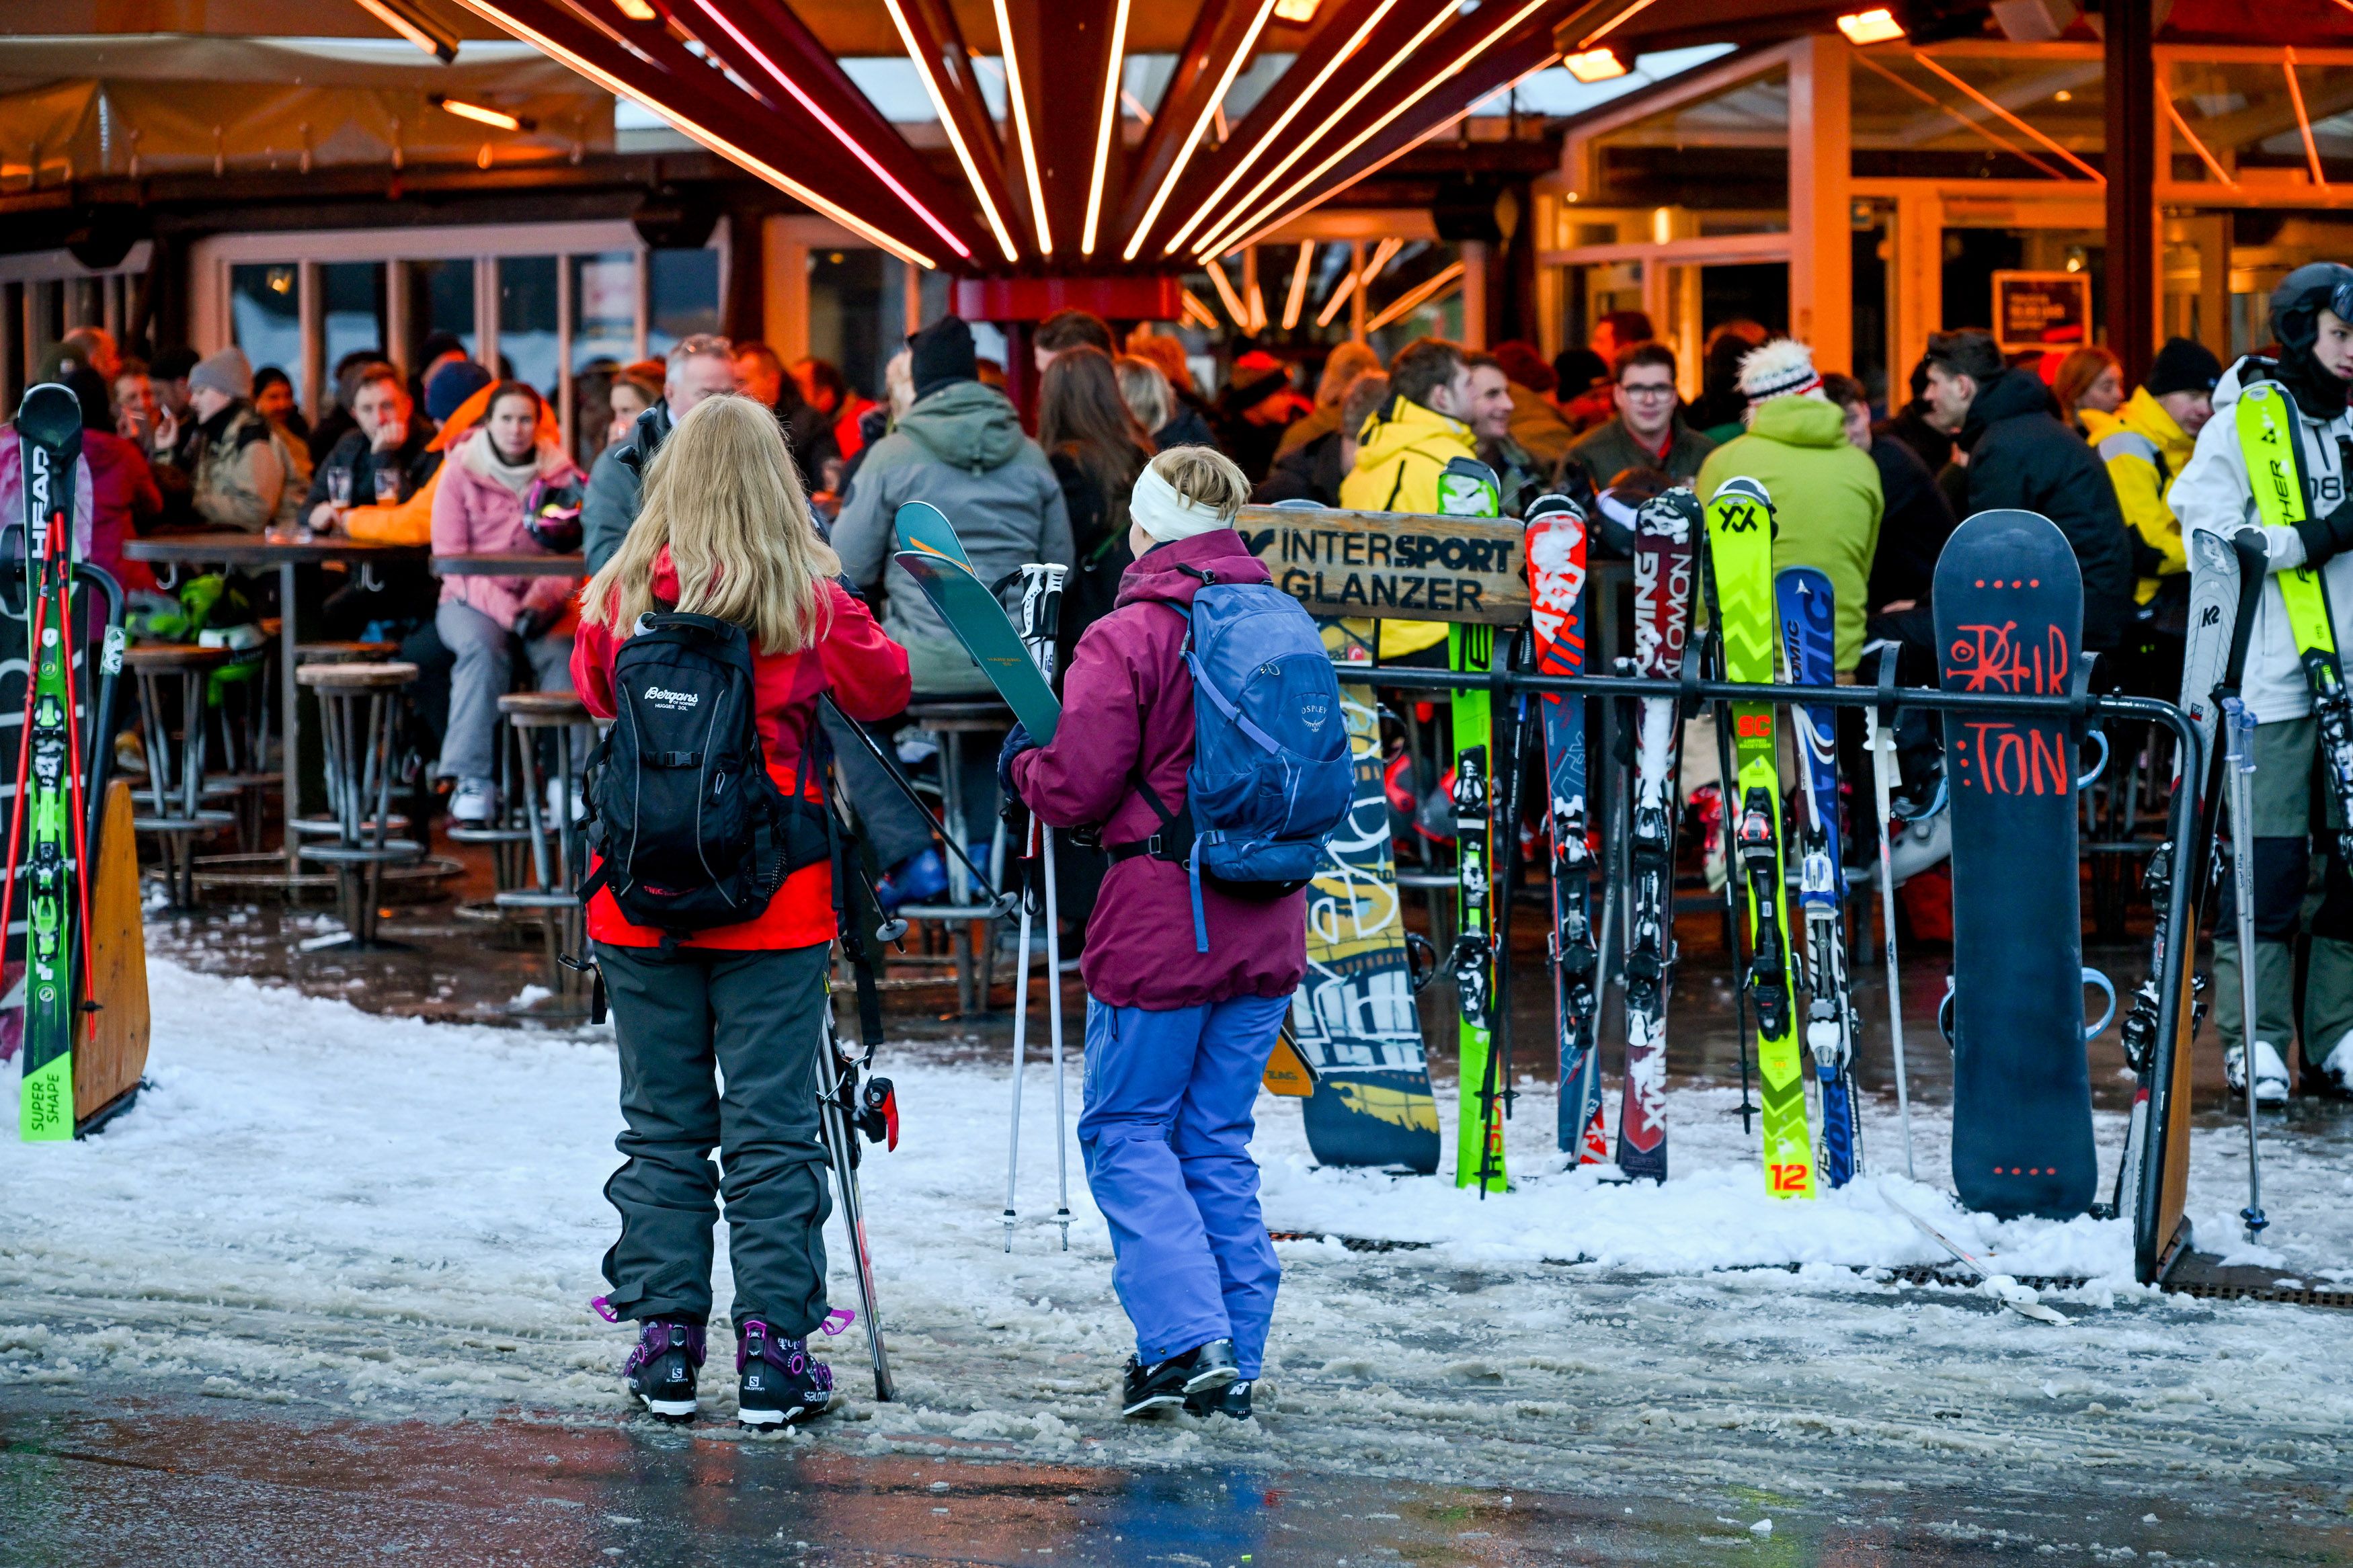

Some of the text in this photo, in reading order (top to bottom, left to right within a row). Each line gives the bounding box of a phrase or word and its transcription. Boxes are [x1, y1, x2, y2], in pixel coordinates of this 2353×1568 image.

[1281, 528, 1515, 573] INTERSPORT
[1027, 589, 1039, 601] LEKI
[1281, 569, 1484, 612] GLANZER
[2202, 605, 2221, 627] K2
[644, 686, 699, 704] Bergans
[1302, 705, 1327, 714] OSPREY
[2192, 706, 2203, 714] 156
[1738, 714, 1771, 737] SC
[32, 1082, 44, 1132] SUPER
[47, 1073, 58, 1124] SHAPE
[1770, 1165, 1807, 1190] 12
